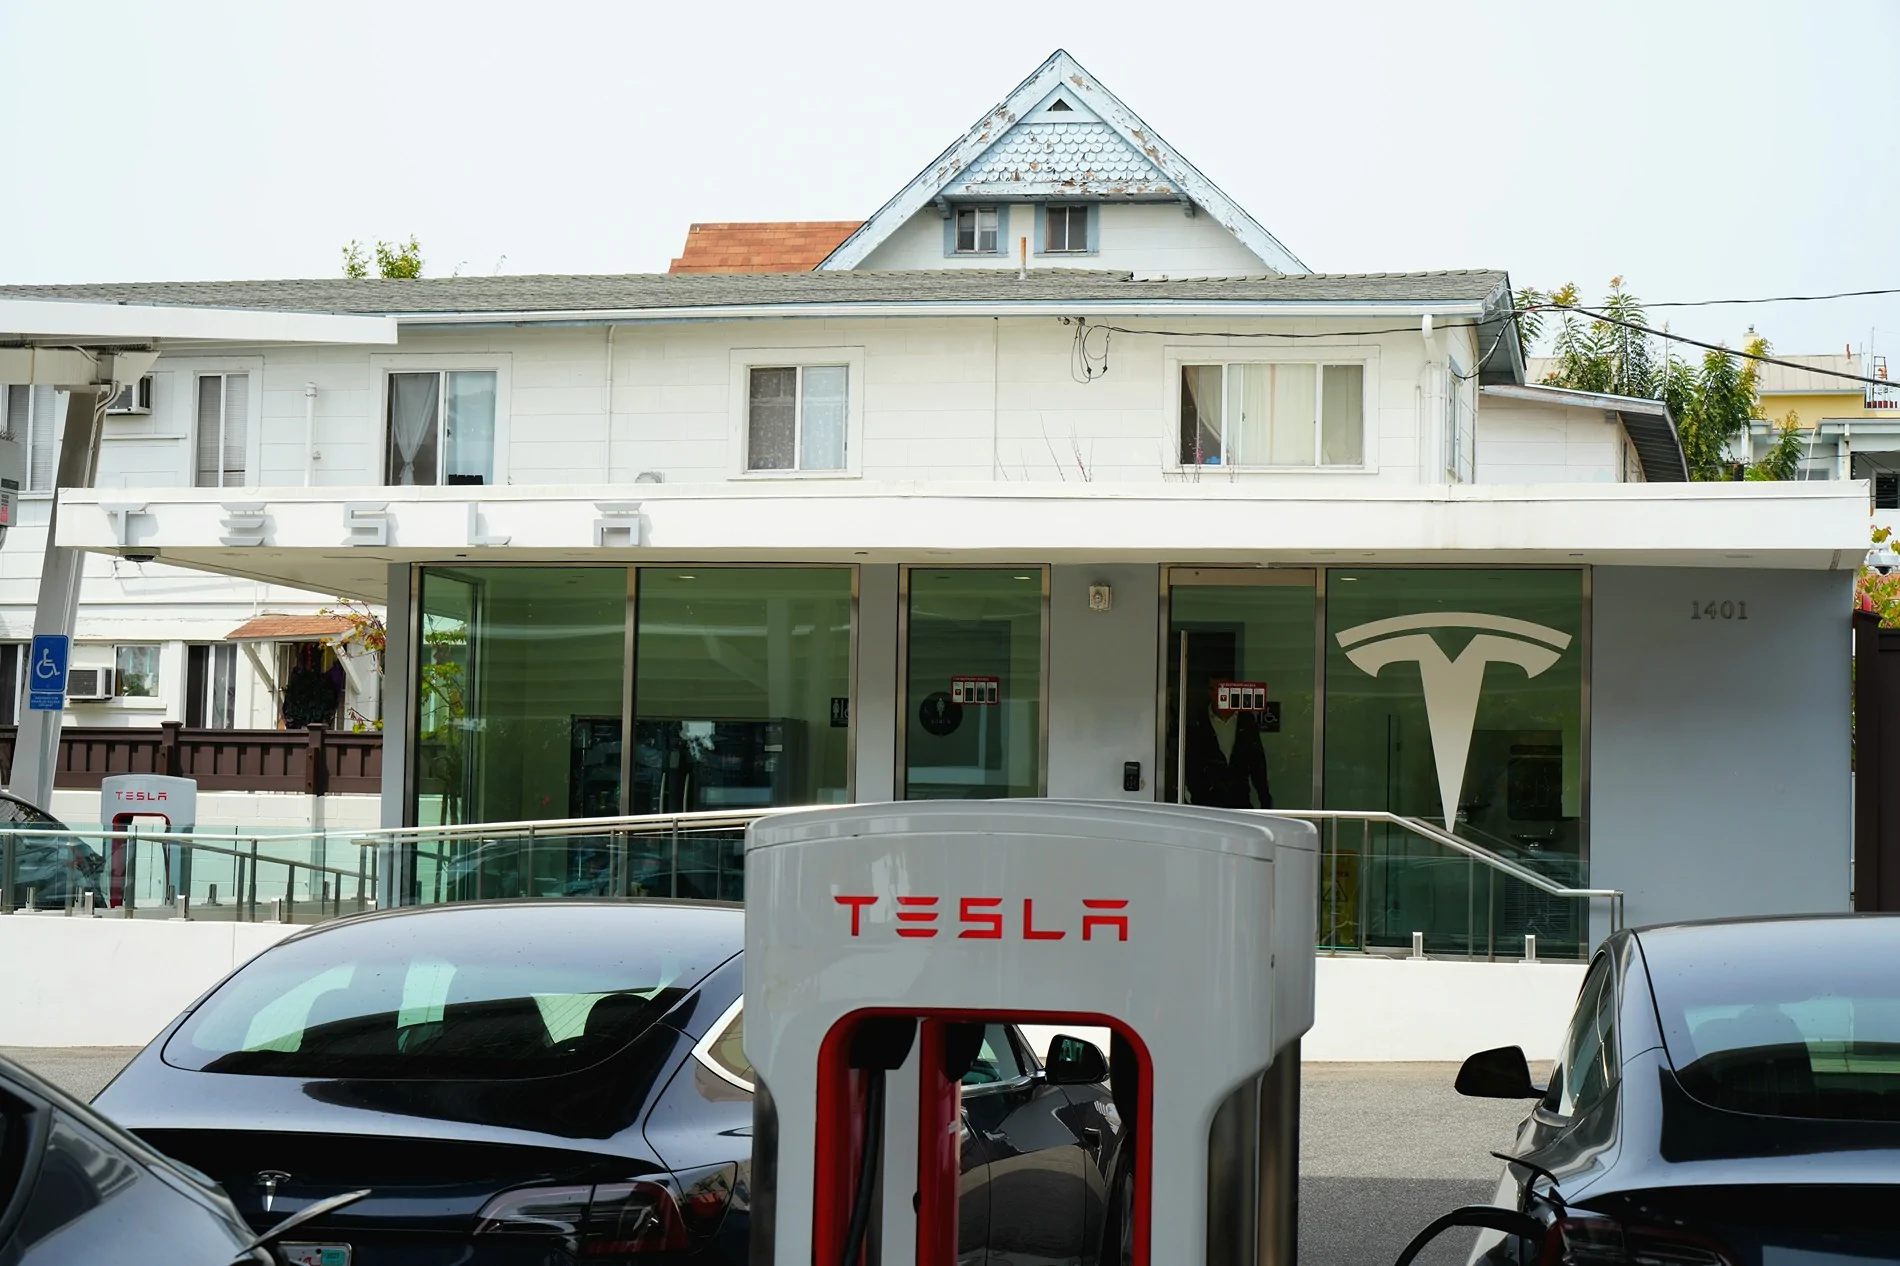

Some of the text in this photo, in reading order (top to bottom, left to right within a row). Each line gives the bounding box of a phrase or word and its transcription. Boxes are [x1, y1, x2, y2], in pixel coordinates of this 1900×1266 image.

[98, 501, 643, 546] TESLA
[1691, 600, 1748, 620] 1401
[115, 791, 167, 801] TESLA
[833, 896, 1129, 941] TESLA
